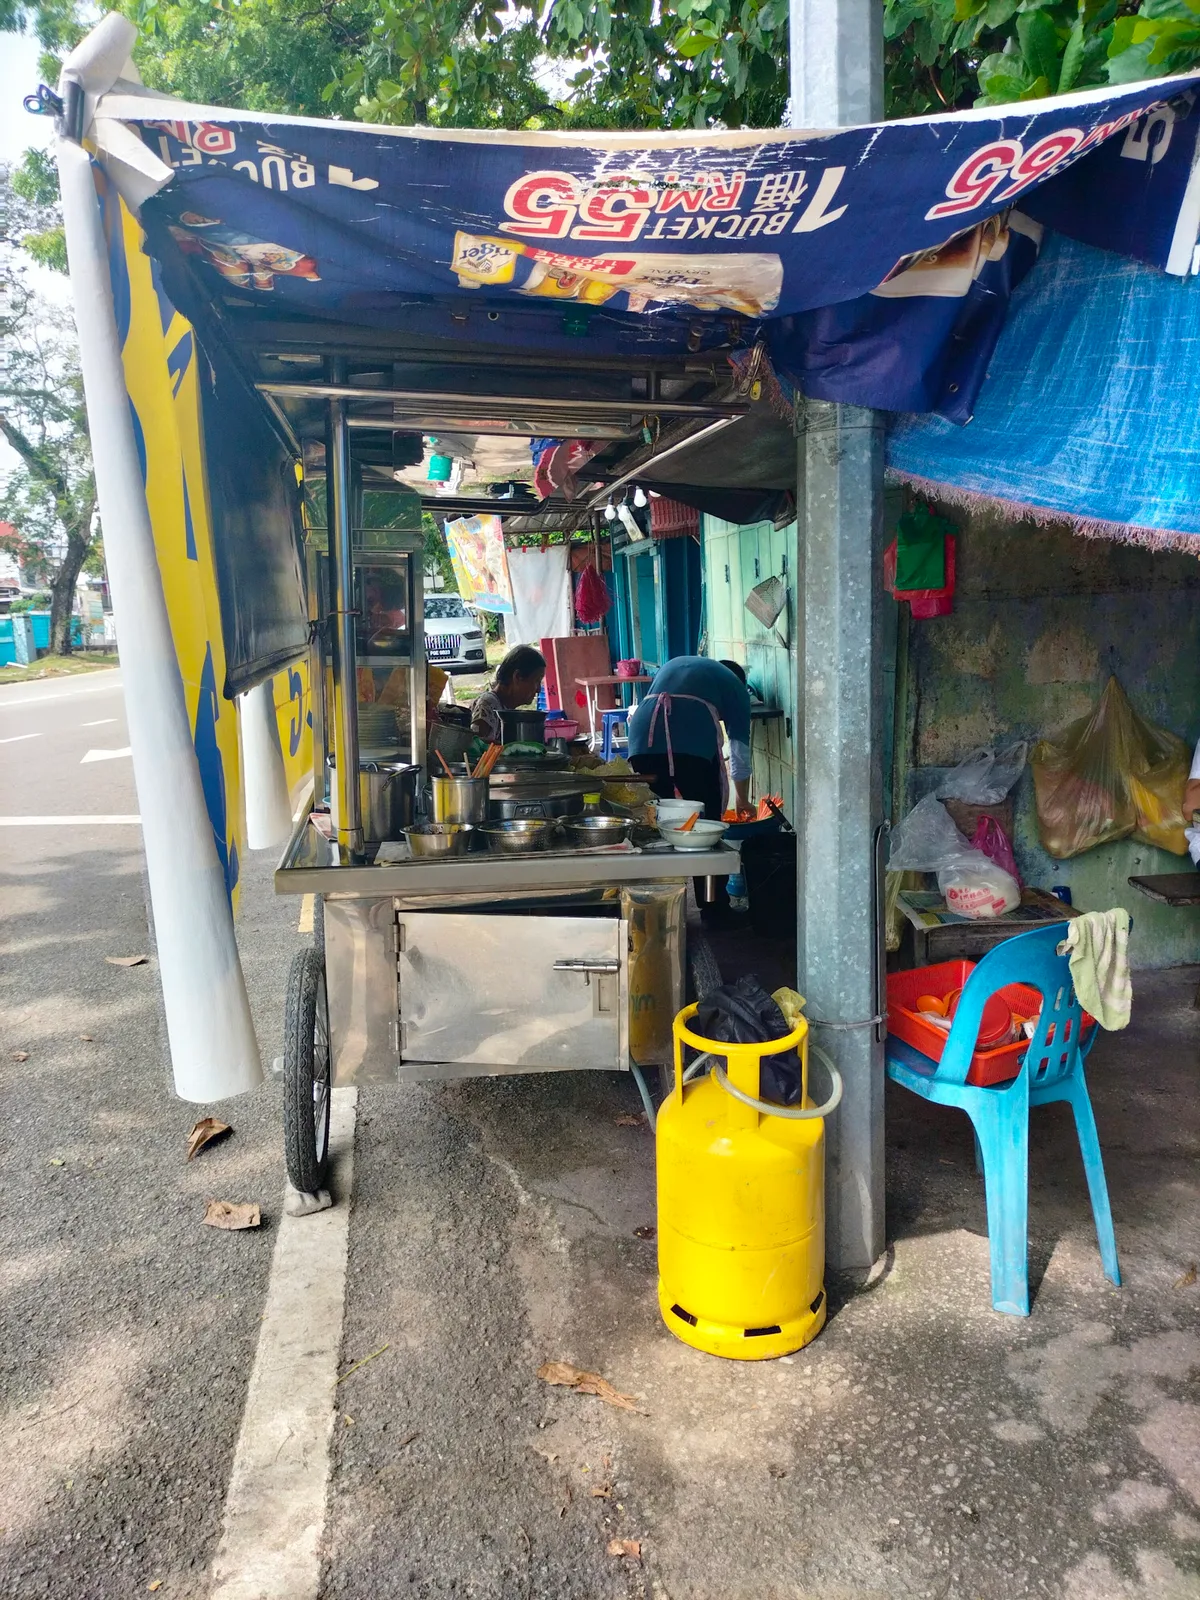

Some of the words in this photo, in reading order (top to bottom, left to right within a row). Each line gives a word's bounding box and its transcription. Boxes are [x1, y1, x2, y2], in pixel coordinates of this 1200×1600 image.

[159, 136, 316, 191] BUCET
[753, 170, 808, 212] 桶
[791, 166, 849, 234] 1
[645, 210, 794, 240] BUCKET
[458, 243, 512, 262] Tiger
[532, 255, 615, 273] FREE
[535, 249, 606, 265] BOTTLE
[648, 268, 712, 277] CRYSTAL
